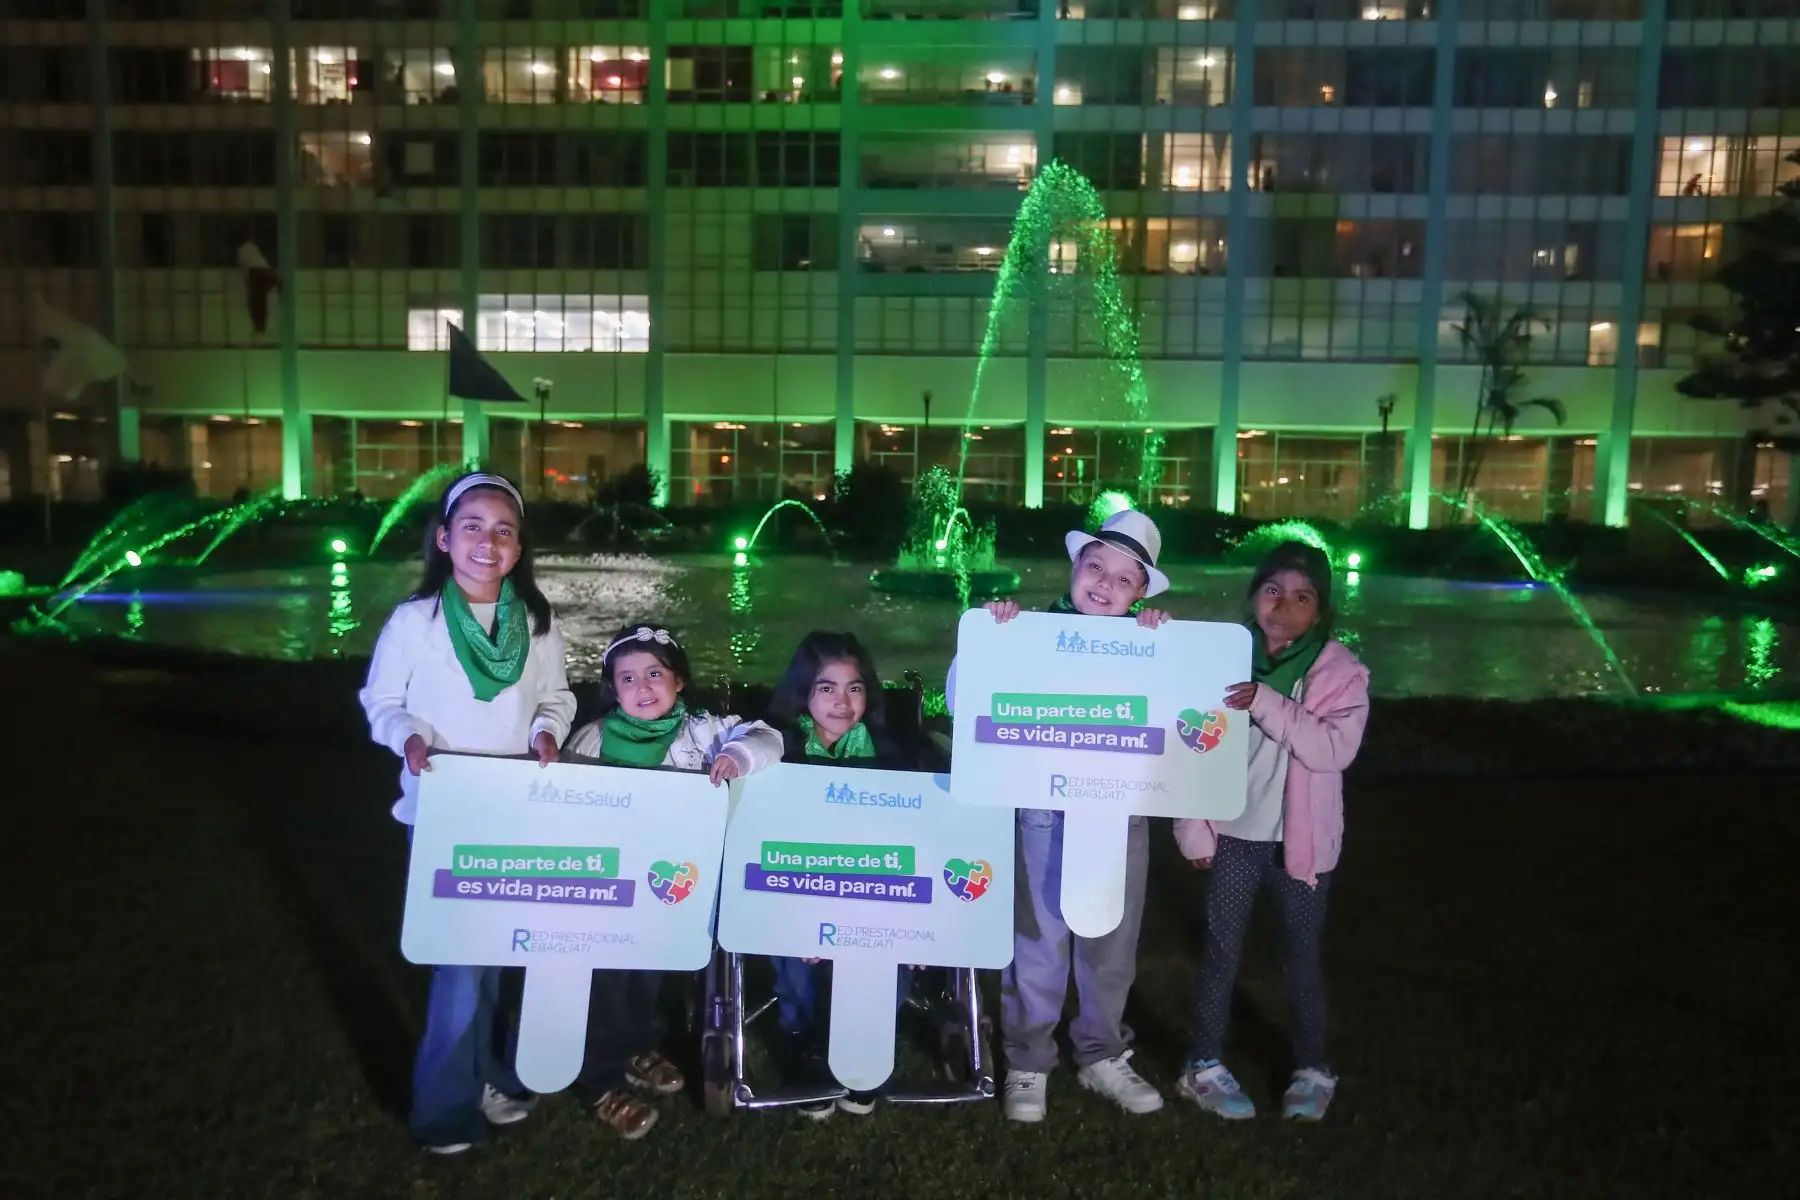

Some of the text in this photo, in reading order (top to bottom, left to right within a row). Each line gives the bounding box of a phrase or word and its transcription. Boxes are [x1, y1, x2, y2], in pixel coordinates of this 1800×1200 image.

[1090, 639, 1155, 658] EsSalud
[997, 702, 1134, 721] Una parte de ti,
[997, 726, 1148, 749] es vida para mí.
[1086, 777, 1169, 792] PRESTACIONAL
[564, 787, 631, 808] EsSalud
[858, 791, 922, 809] EsSalud
[458, 854, 605, 874] Una parte de ti,
[767, 851, 902, 871] Una parte de ti,
[457, 878, 618, 901] es vida para mí.
[766, 873, 917, 898] es vida para mí.
[550, 931, 635, 946] PRESTACIONAL
[855, 928, 937, 942] PRESTACIONAL
